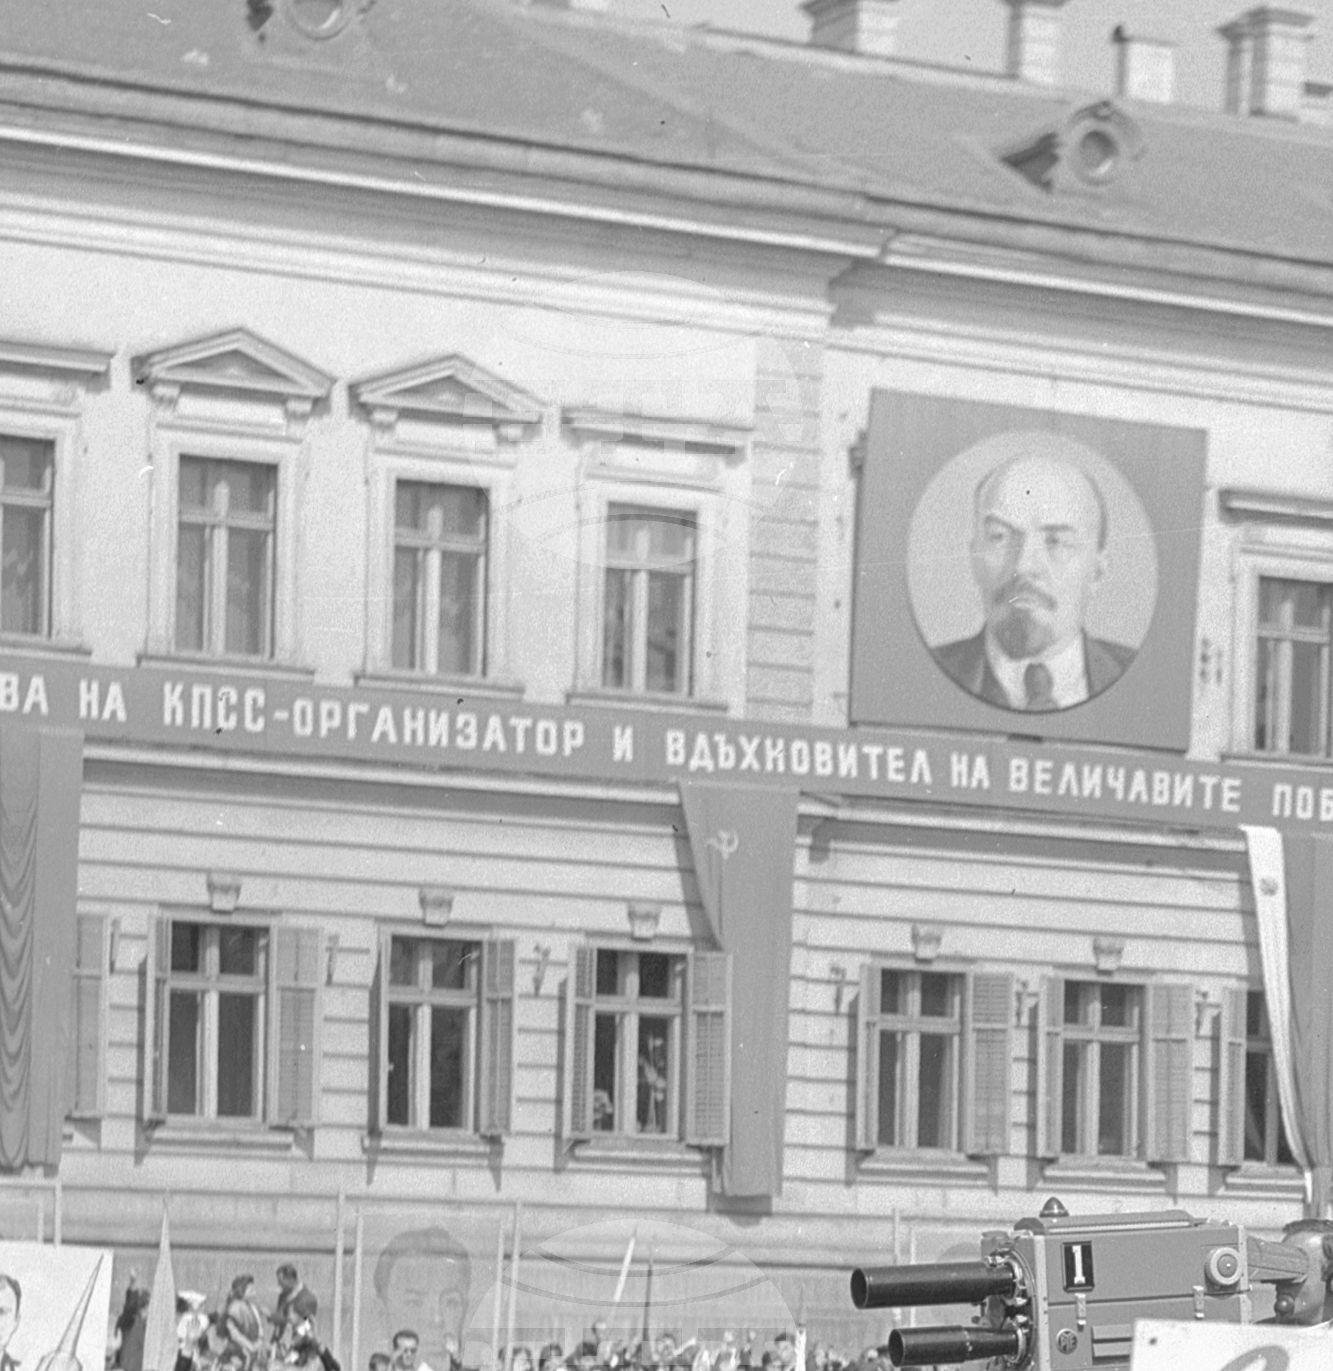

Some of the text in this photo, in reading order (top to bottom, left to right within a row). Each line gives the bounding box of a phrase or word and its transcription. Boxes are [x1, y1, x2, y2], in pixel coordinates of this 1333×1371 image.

[79, 677, 128, 723] НА
[162, 682, 586, 757] КПСС-ОРГАНИЗАТОР
[613, 726, 634, 763] И
[665, 729, 932, 787] ВДЪХНОВИТЕЛ
[950, 752, 991, 791] НА
[1009, 756, 1241, 814] ВЕЛИЧАВИТЕ
[1071, 1244, 1087, 1285] 1
